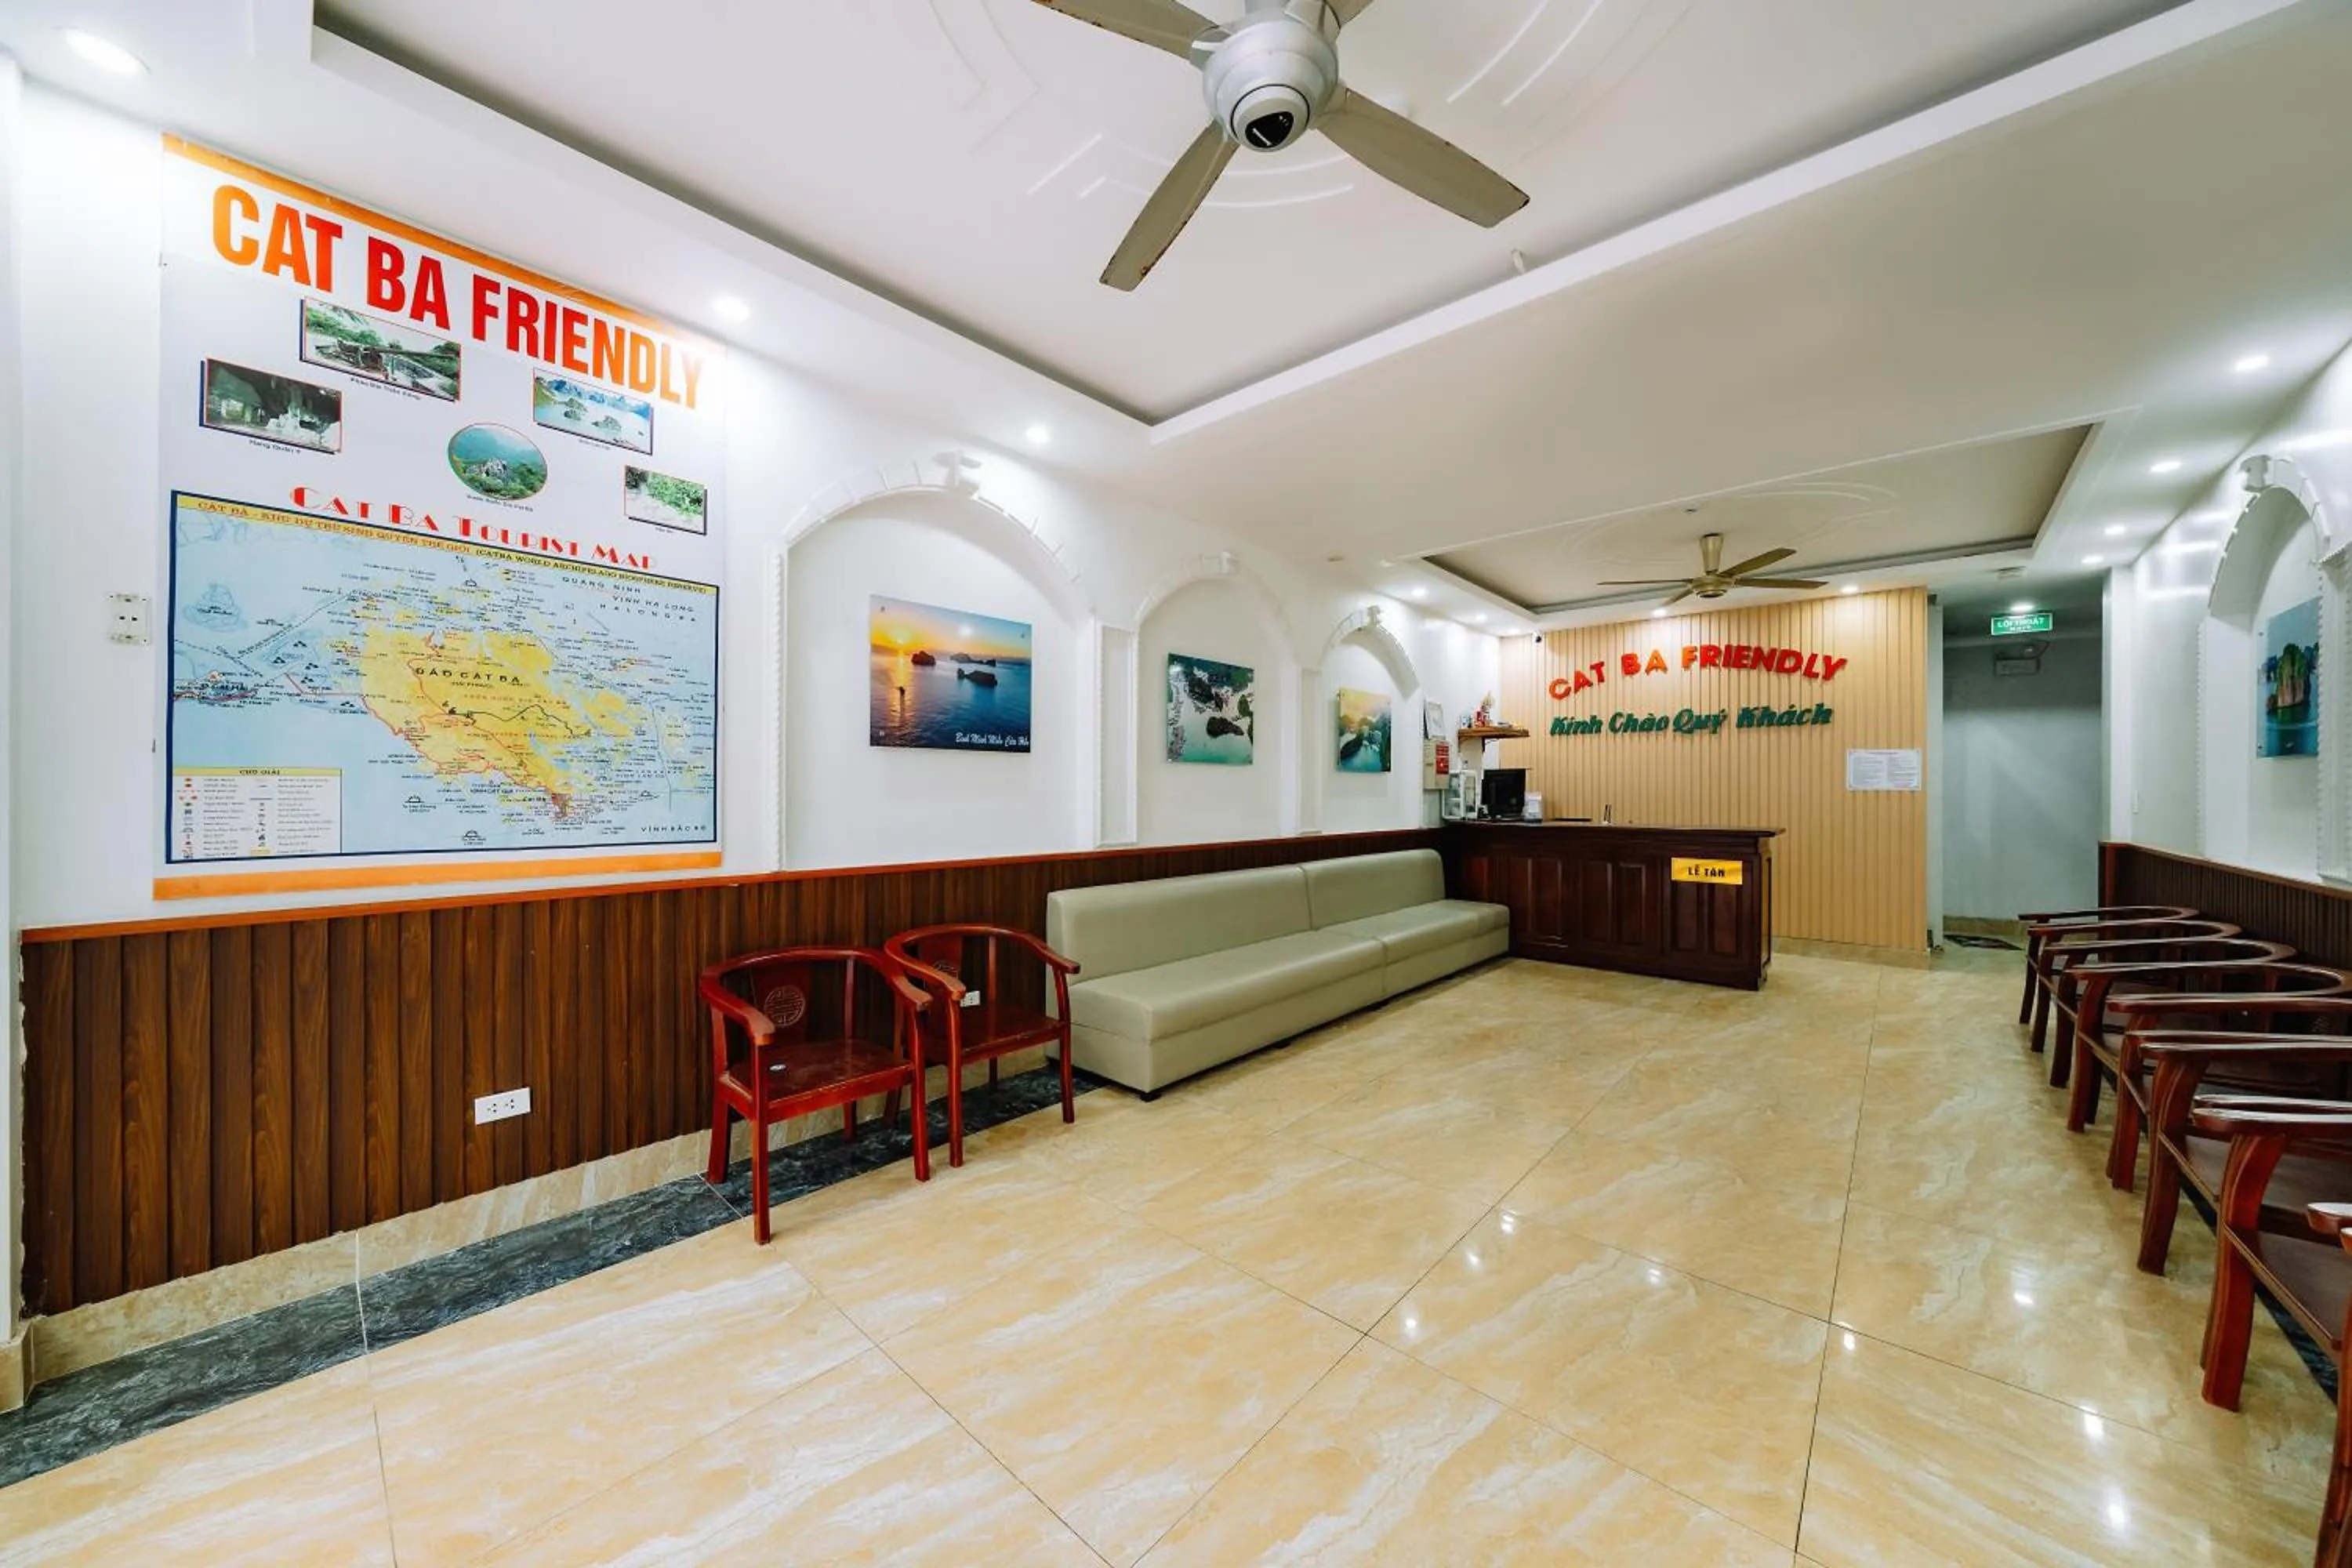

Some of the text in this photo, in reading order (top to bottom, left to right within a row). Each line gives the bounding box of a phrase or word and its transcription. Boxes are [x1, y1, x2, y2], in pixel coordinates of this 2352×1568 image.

[212, 185, 705, 410] CAT BA FRIENDLY
[1548, 643, 1848, 700] CAT BA FRIENDLY
[1608, 710, 1670, 734] Chào
[1672, 707, 1727, 735] Quý
[1735, 702, 1833, 729] Khách
